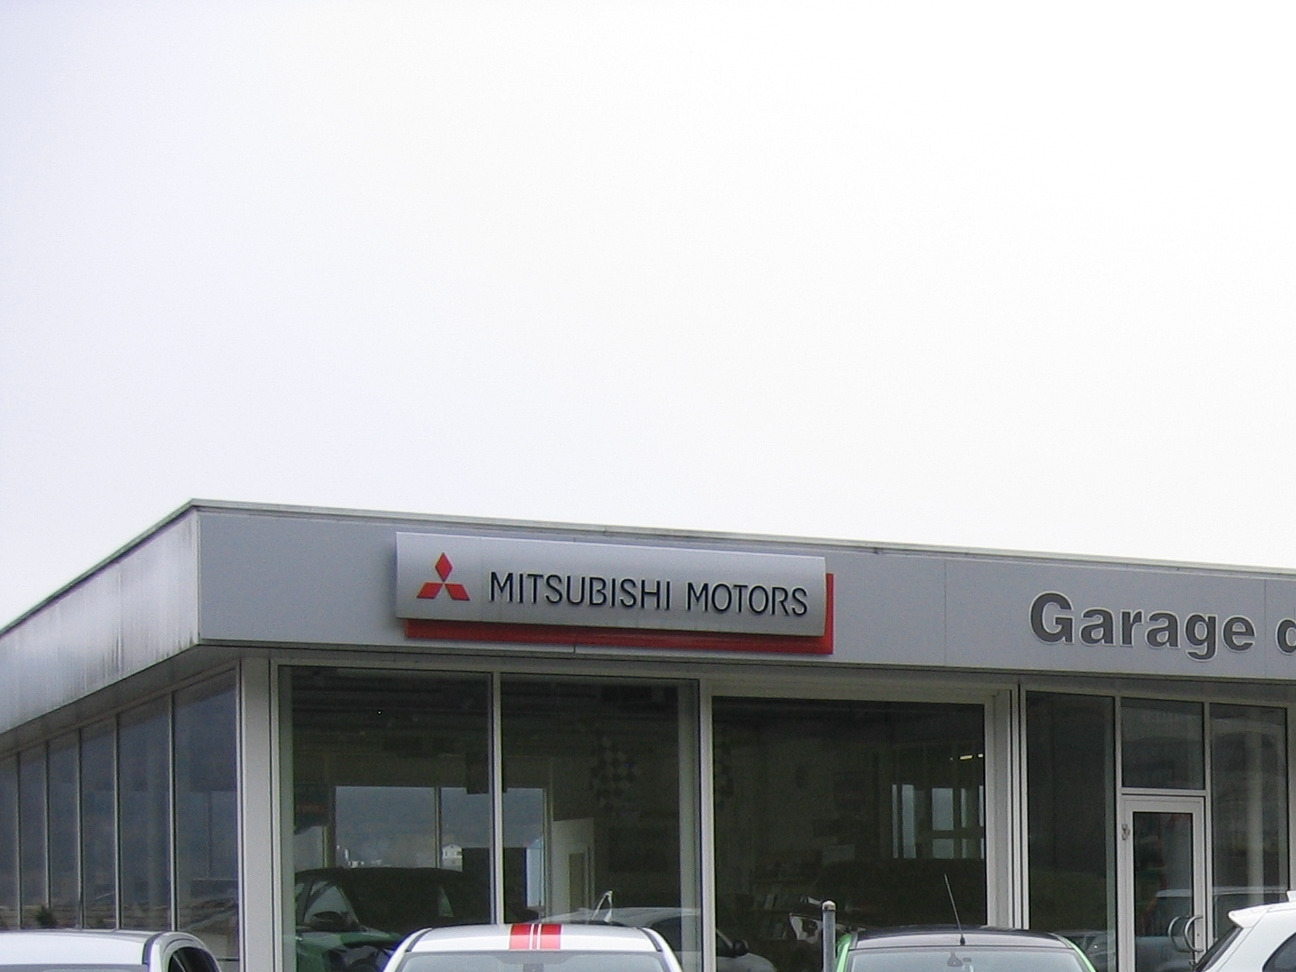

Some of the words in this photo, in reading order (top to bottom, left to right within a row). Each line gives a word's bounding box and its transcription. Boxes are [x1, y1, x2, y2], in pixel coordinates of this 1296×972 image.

[489, 571, 671, 611] MITSUBISHI
[686, 582, 809, 617] MOTORS
[1029, 591, 1257, 661] Garage
